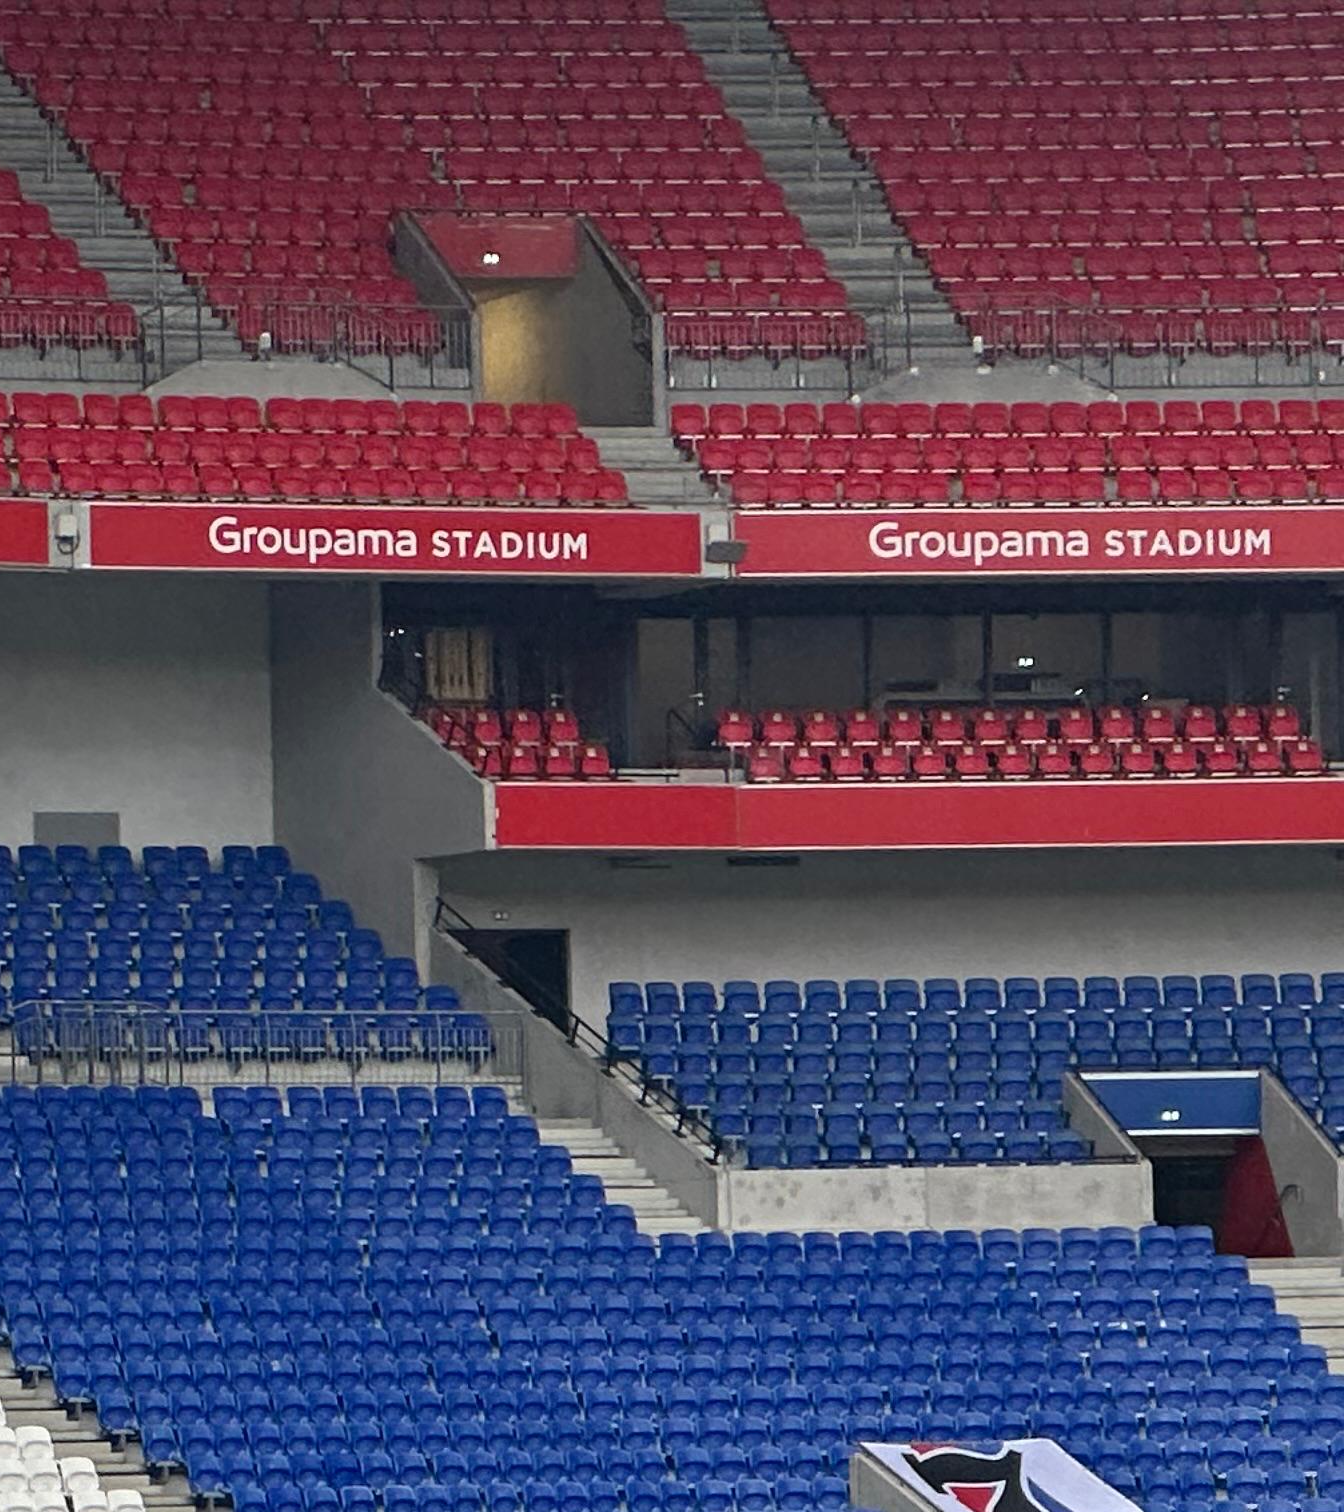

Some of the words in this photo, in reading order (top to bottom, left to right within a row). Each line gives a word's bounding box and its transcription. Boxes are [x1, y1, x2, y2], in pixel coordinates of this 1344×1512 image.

[208, 516, 418, 564] Groupama
[431, 530, 588, 560] STADIUM
[868, 521, 1090, 566] Groupama
[1104, 528, 1271, 558] STADIUM
